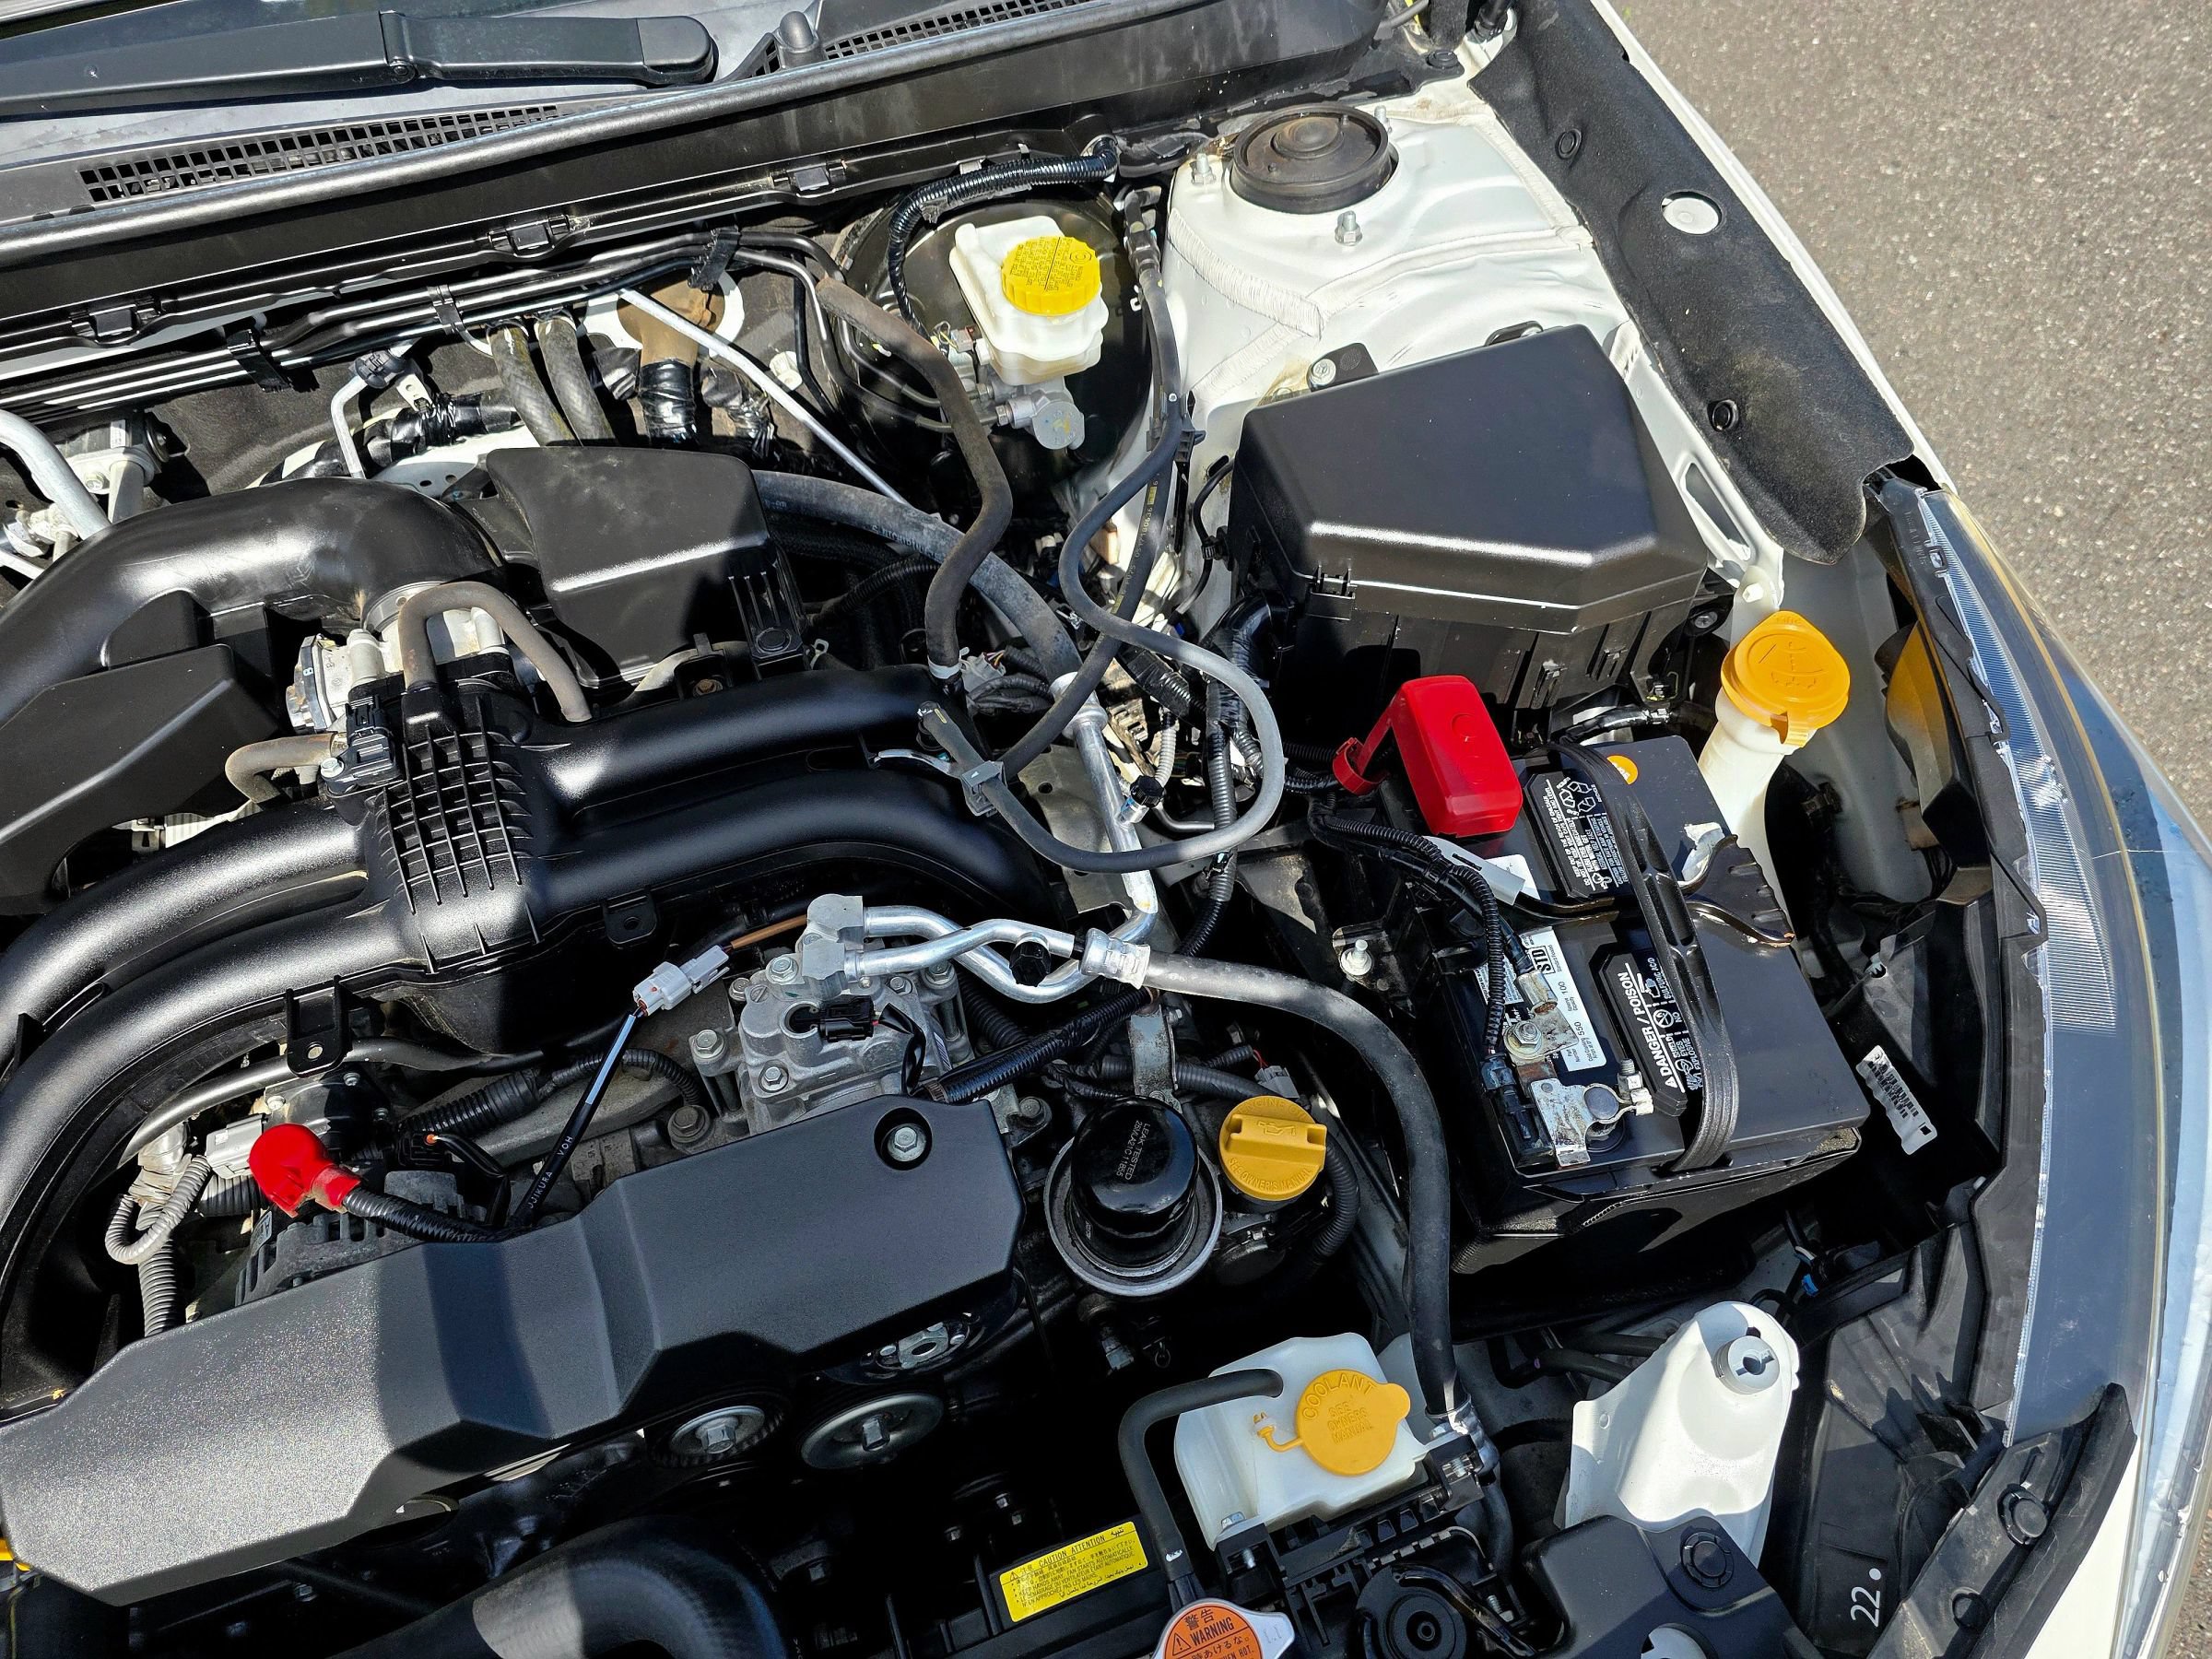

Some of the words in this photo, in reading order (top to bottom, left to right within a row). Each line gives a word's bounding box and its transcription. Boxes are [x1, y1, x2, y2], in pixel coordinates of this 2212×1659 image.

[1532, 947, 1551, 973] STD
[1648, 958, 1658, 971] ACID
[1558, 982, 1568, 994] 100
[1618, 972, 1644, 1015] POISON
[1654, 972, 1671, 998] SULFURIC
[1574, 1022, 1584, 1035] 550
[1672, 1012, 1682, 1022] NO
[1642, 1027, 1671, 1076] DANGER
[1665, 1035, 1680, 1057] SHIELD
[1676, 1041, 1688, 1056] EYES
[1682, 1038, 1700, 1069] EXPLOSIVE
[1137, 1124, 1150, 1145] LEAK
[1125, 1147, 1142, 1180] TESTED
[1229, 1158, 1242, 1173] SEE
[1241, 1171, 1280, 1191] OWNER'S
[1282, 1167, 1312, 1190] MANUAL
[1302, 1373, 1377, 1419] COOLANT
[1327, 1406, 1368, 1431] OWNERS
[1328, 1401, 1351, 1418] SEE
[1331, 1422, 1373, 1444] MANUAL
[1039, 1550, 1066, 1567] CAUTION
[1072, 1535, 1105, 1553] ATTENTION
[1183, 1606, 1214, 1630] 警告
[1190, 1618, 1234, 1645] WARNING
[1239, 1646, 1254, 1658] HOT.
